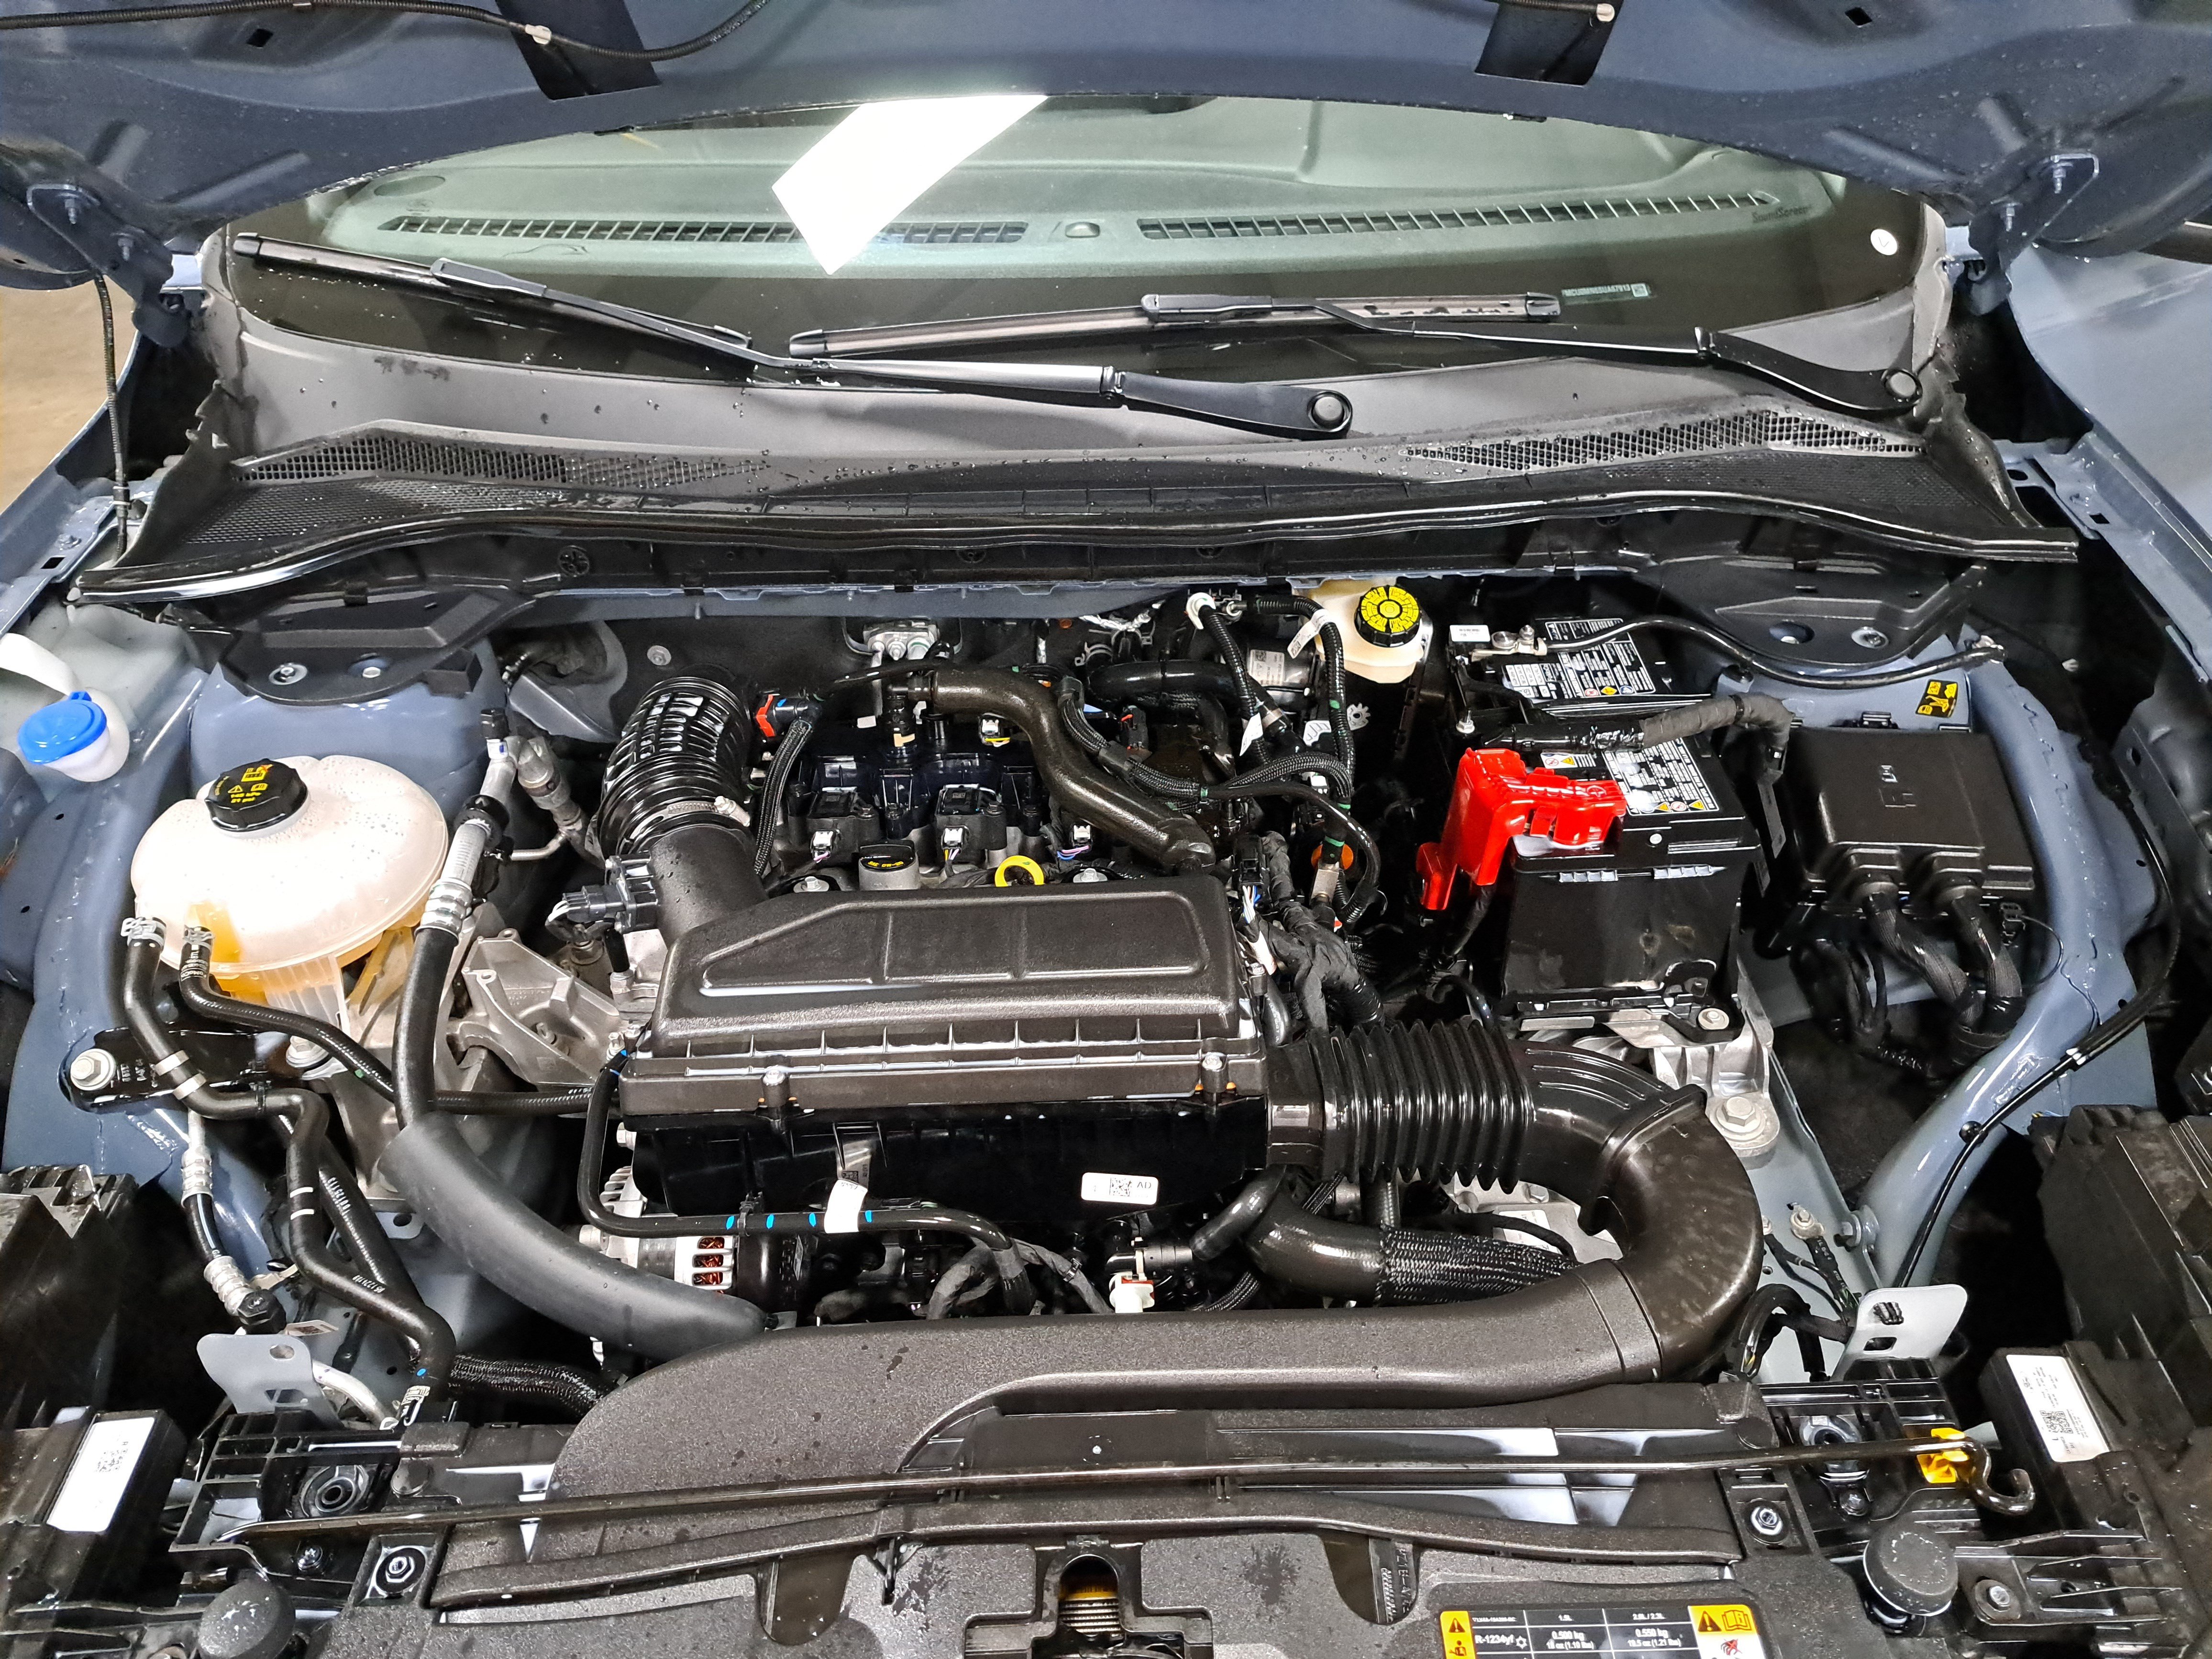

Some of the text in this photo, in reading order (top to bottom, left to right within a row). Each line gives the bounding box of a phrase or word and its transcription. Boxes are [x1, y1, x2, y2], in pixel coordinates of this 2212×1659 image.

[1573, 1631, 1585, 1641] kg
[1657, 1628, 1669, 1638] kg
[1474, 1634, 1515, 1646] R-1234yf
